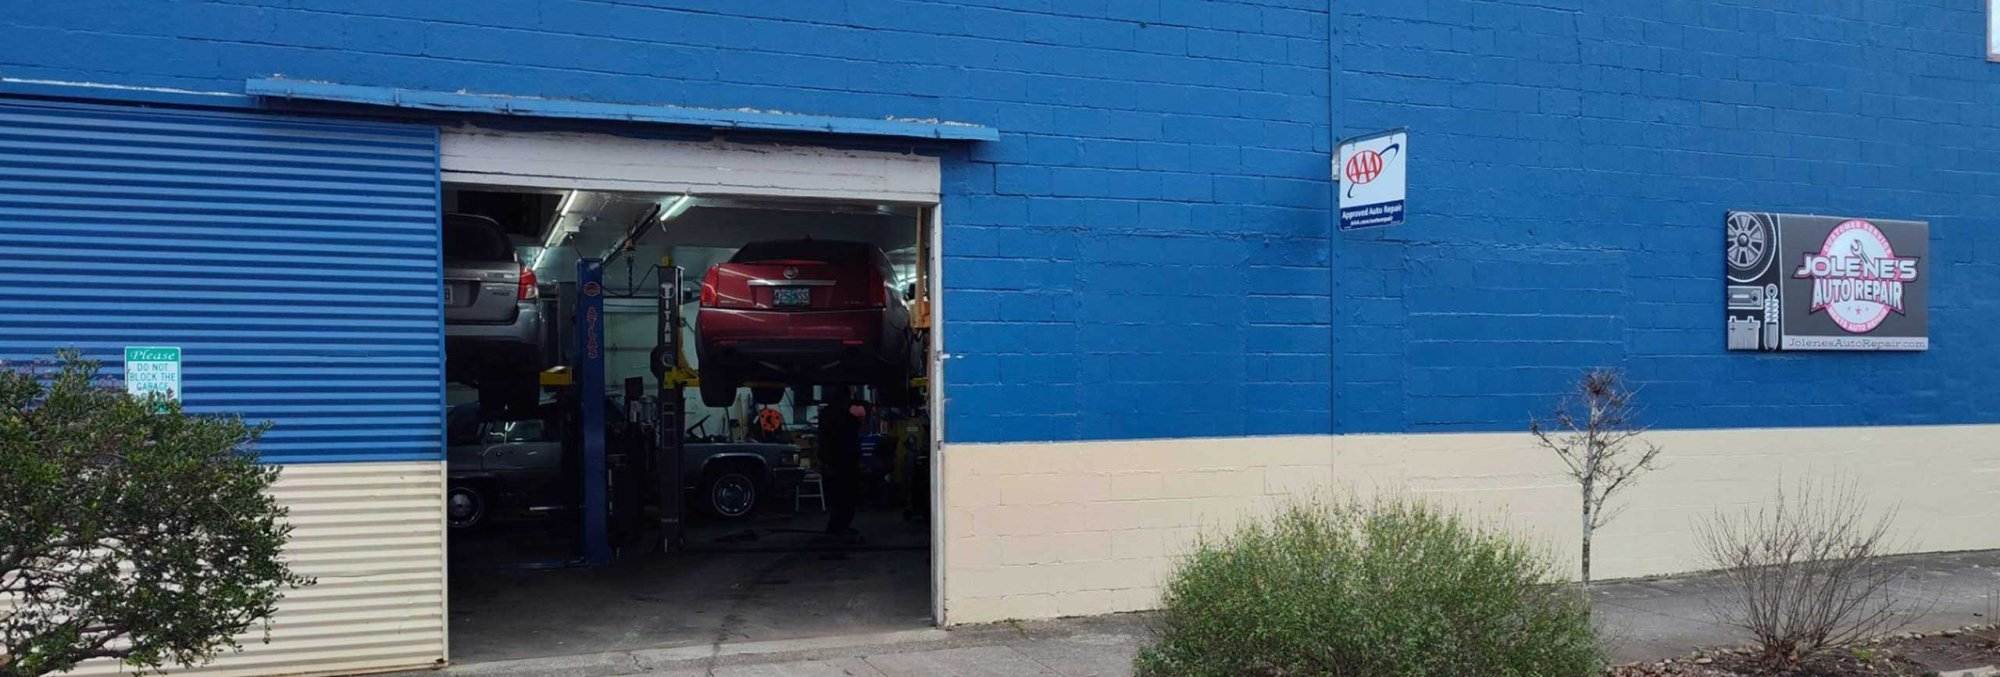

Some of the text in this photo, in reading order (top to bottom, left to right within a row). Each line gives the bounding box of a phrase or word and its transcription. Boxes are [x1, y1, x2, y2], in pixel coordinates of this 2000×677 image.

[1349, 151, 1378, 182] AAA
[1342, 204, 1402, 220] Approved Auto Repair
[1796, 255, 1919, 280] JOLENE'S
[1813, 279, 1902, 310] AUTO REPAIR
[660, 282, 675, 343] TITAN
[1788, 338, 1926, 350] JolenesAutoRepair.com
[130, 349, 175, 360] Please
[137, 363, 168, 371] DO NOT
[129, 372, 176, 381] BLOCK THE
